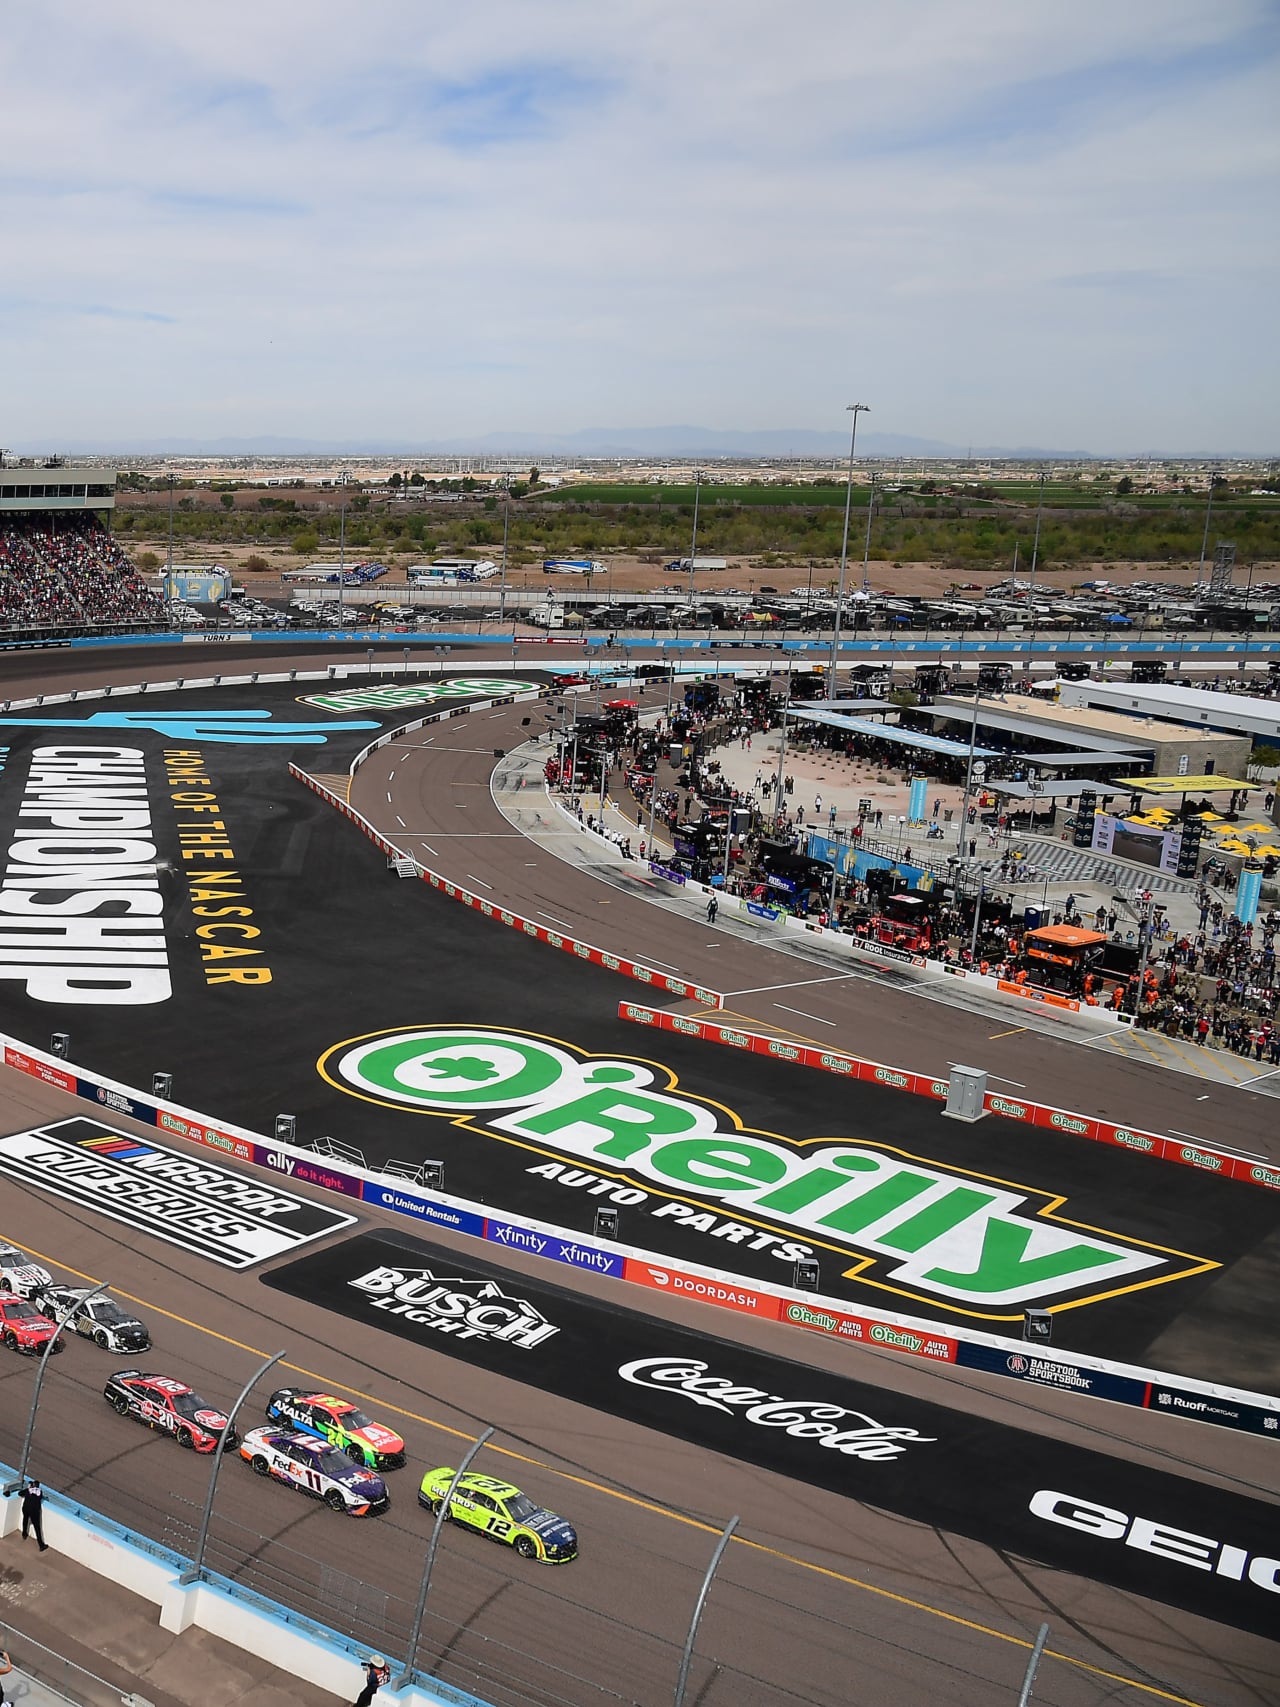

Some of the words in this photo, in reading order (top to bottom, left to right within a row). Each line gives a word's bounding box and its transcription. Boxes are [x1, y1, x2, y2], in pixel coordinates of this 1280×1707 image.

[163, 750, 211, 785] HOME
[170, 792, 220, 813] OF
[177, 821, 234, 859] THE
[186, 871, 273, 985] NASCAR
[266, 1152, 295, 1176] ally
[340, 1031, 1169, 1306] O'Reilly
[120, 1152, 302, 1218] NASCAR
[297, 1167, 308, 1178] do
[309, 1169, 318, 1180] it
[319, 1175, 344, 1190] right.
[25, 1152, 118, 1184] CUP
[97, 1180, 258, 1238] SERIES
[395, 1196, 424, 1214] United
[425, 1207, 461, 1225] Rentals
[525, 1162, 648, 1206] AUTO
[651, 1203, 821, 1263] PARTS
[495, 1226, 547, 1252] xfinity
[560, 1244, 614, 1273] xfinity
[673, 1276, 758, 1308] DOORDASH
[347, 1266, 560, 1349] BUSCH
[370, 1296, 487, 1340] LIGHT
[787, 1304, 838, 1332] O'Reilly
[839, 1326, 863, 1339] PARTS
[841, 1320, 862, 1331] AUTO
[870, 1324, 923, 1352] O'Reilly
[923, 1347, 949, 1359] PARTS
[927, 1340, 948, 1351] AUTO
[1029, 1368, 1091, 1389] SPORTSBOOK
[1030, 1358, 1080, 1378] BARSTOOL
[273, 1399, 313, 1427] AXALTA
[618, 1357, 938, 1461] Coca-Cola
[1173, 1396, 1207, 1412] Ruoff
[158, 1410, 174, 1431] 20
[327, 1428, 344, 1449] 24
[272, 1455, 303, 1478] FedEx
[305, 1470, 322, 1491] 11
[486, 1517, 512, 1537] 12
